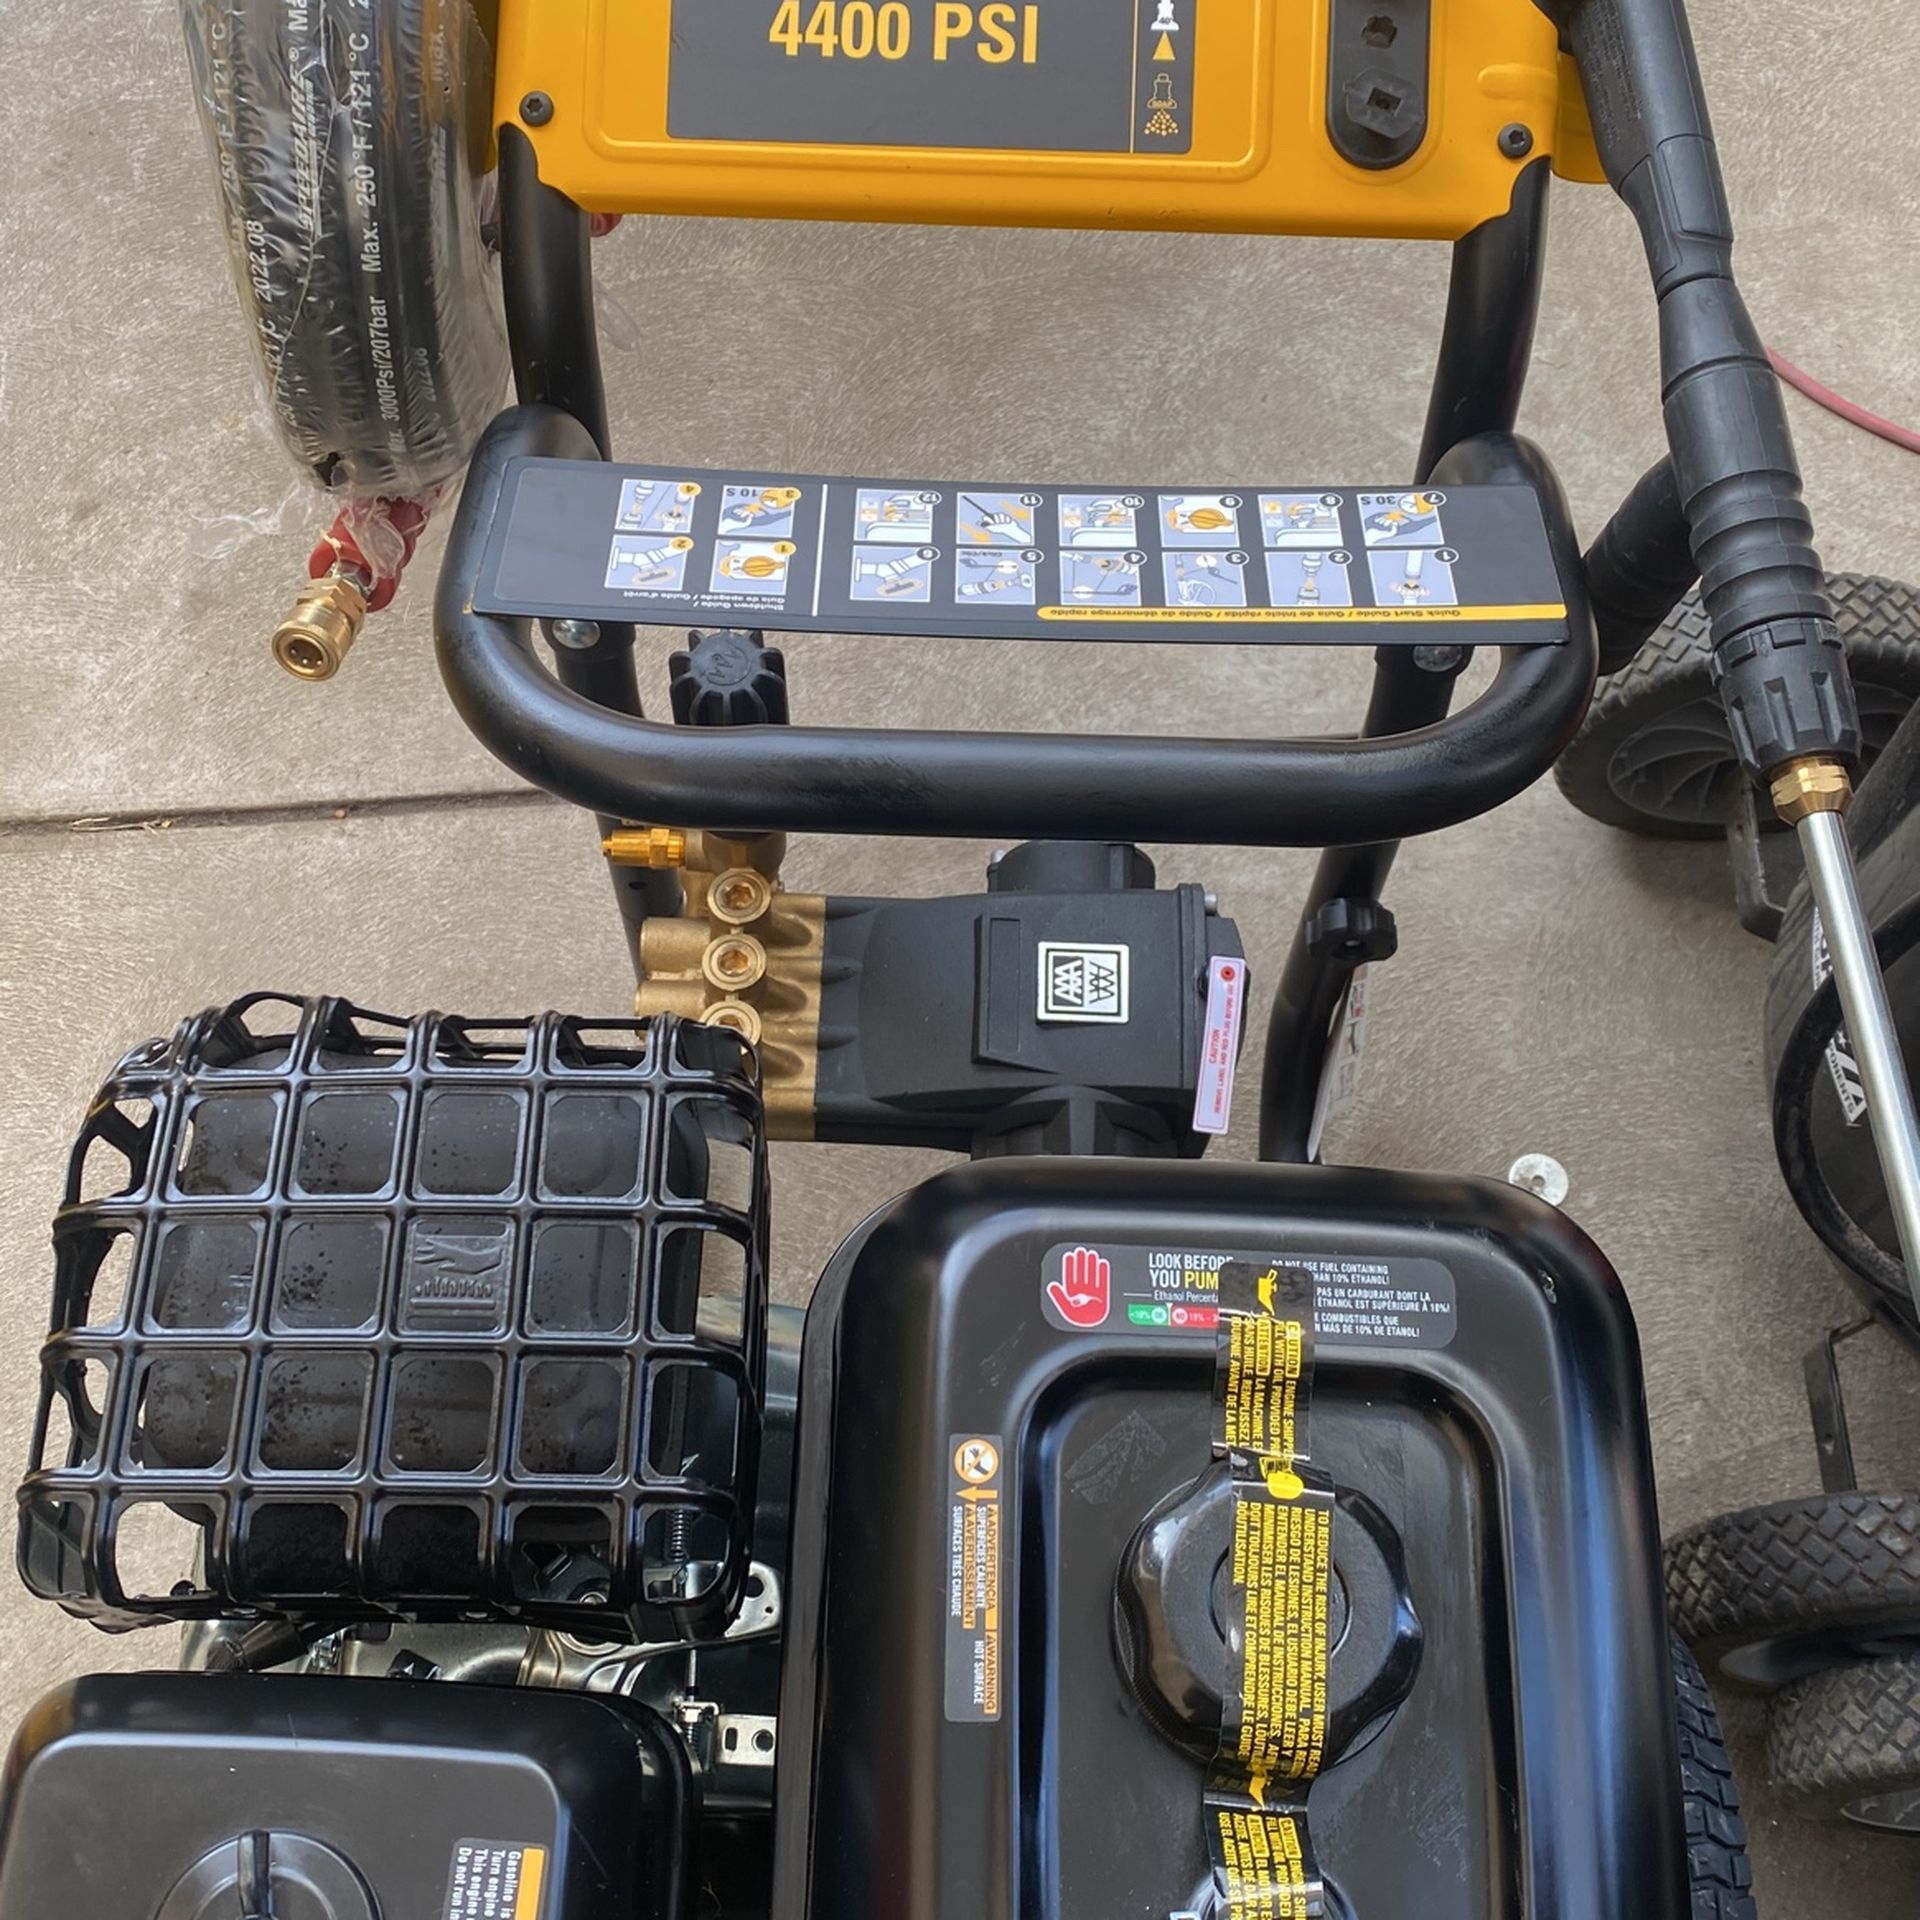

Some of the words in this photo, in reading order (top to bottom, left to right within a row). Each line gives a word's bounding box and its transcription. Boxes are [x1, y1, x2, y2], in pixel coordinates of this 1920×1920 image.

[769, 0, 910, 60] 4400
[934, 3, 1039, 64] PSI
[354, 164, 377, 208] 250
[361, 221, 382, 272] Max.
[246, 220, 273, 302] 2022.08
[369, 296, 400, 422] 3000Psi/207bar
[726, 488, 735, 496] S
[741, 488, 757, 497] 10
[1360, 496, 1371, 505] S
[1376, 496, 1395, 505] 30
[1356, 610, 1391, 618] Guide
[1208, 1029, 1221, 1064] CAUTION
[1148, 1253, 1183, 1269] LOOK
[1320, 1262, 1339, 1272] FUEL
[1341, 1264, 1389, 1274] CONTAINING
[1149, 1269, 1180, 1288] YOU
[1185, 1271, 1219, 1289] PUM
[1332, 1273, 1349, 1282] 10%
[1351, 1274, 1390, 1285] ETHANOL!
[1154, 1290, 1184, 1301] Ethanol
[1316, 1286, 1333, 1296] PAS
[1334, 1287, 1345, 1297] UN
[1348, 1288, 1394, 1299] CARBURANT
[1396, 1291, 1417, 1301] DONT
[1419, 1292, 1431, 1301] LA
[1356, 1299, 1370, 1309] EST
[1372, 1298, 1419, 1312] SUPÉRIEURE
[1321, 1312, 1381, 1324] COMBUSTIBLES
[1383, 1316, 1399, 1325] QUE
[1323, 1321, 1341, 1333] MÁS
[1343, 1324, 1353, 1333] DE
[1355, 1325, 1372, 1334] 10%
[1374, 1326, 1385, 1335] DE
[1244, 1319, 1255, 1345] SANS
[1257, 1322, 1270, 1373] ATTENTION
[1274, 1340, 1284, 1366] WITH
[1287, 1324, 1299, 1374] CUTION
[1228, 1359, 1239, 1392] AVANT
[1255, 1378, 1265, 1390] LA
[1273, 1368, 1283, 1383] OIL
[1227, 1395, 1237, 1407] DE
[1239, 1379, 1252, 1441] REMPLISSEZ
[1270, 1386, 1282, 1435] PROVIDED
[1284, 1380, 1295, 1417] ENGINE
[1226, 1410, 1236, 1423] LA
[1253, 1392, 1264, 1439] MACHINE
[1249, 1502, 1261, 1527] DOIT
[1290, 1507, 1302, 1546] RIESGO
[1318, 1510, 1329, 1524] TO
[952, 1506, 962, 1552] SURFACES
[976, 1506, 986, 1563] SUPERFICIES
[1261, 1504, 1275, 1564] MINIMISER
[1275, 1506, 1289, 1562] ENTENDER
[1247, 1530, 1260, 1588] TOUJOURS
[1289, 1548, 1301, 1563] DE
[1303, 1509, 1316, 1584] UNDERSTAND
[1316, 1526, 1329, 1569] REDUCE
[964, 1520, 975, 1626] AVERTISSEMENT
[986, 1520, 997, 1610] ADVERTENCIA
[1261, 1566, 1273, 1586] LES
[1275, 1564, 1286, 1577] EL
[975, 1565, 985, 1609] CALIENTE
[1287, 1565, 1301, 1620] LESIONES,
[1316, 1571, 1327, 1593] THE
[952, 1579, 961, 1616] CHAUDE
[1246, 1590, 1258, 1613] LIRE
[1273, 1579, 1286, 1627] MANUAL
[1315, 1595, 1327, 1619] RISK
[1246, 1615, 1257, 1629] ET
[1259, 1588, 1272, 1635] RISQUES
[1301, 1585, 1313, 1658] INSTRUCTION
[1273, 1630, 1285, 1644] DE
[1287, 1623, 1298, 1635] EL
[1315, 1622, 1326, 1636] OF
[974, 1641, 984, 1659] HOT
[1259, 1638, 1270, 1652] DE
[1242, 1631, 1257, 1708] COMPRENDRE
[1286, 1638, 1299, 1687] USUARIO
[1313, 1638, 1327, 1680] INJURY,
[974, 1662, 984, 1704] SURFACE
[986, 1650, 996, 1710] WARNING
[1256, 1654, 1270, 1721] BLESSURES,
[1285, 1689, 1297, 1719] DEBE
[1313, 1682, 1325, 1712] USER
[1243, 1710, 1254, 1723] LE
[1237, 1725, 1253, 1756] GUIDE
[1283, 1721, 1295, 1747] LEER
[1297, 1718, 1310, 1748] PARA
[1311, 1714, 1324, 1748] MUST
[1219, 1811, 1231, 1828] USE
[1221, 1828, 1233, 1837] EL
[457, 1847, 472, 1863] Do
[472, 1848, 488, 1873] This
[490, 1849, 506, 1875] Turn
[1223, 1837, 1238, 1866] ACEITE
[1255, 1858, 1267, 1869] EL
[455, 1865, 467, 1884] not
[502, 1851, 521, 1902] Gasoline
[1227, 1866, 1240, 1887] QUE
[1242, 1870, 1255, 1884] DE
[1290, 1859, 1304, 1896] ENGINE
[451, 1887, 463, 1906] run
[466, 1875, 481, 1915] engine
[484, 1877, 499, 1917] engine
[1230, 1889, 1243, 1903] SE
[1243, 1884, 1258, 1908] DAR
[1256, 1869, 1273, 1908] MOTOR
[1275, 1864, 1292, 1917] PROVIDED
[500, 1907, 514, 1919] is
